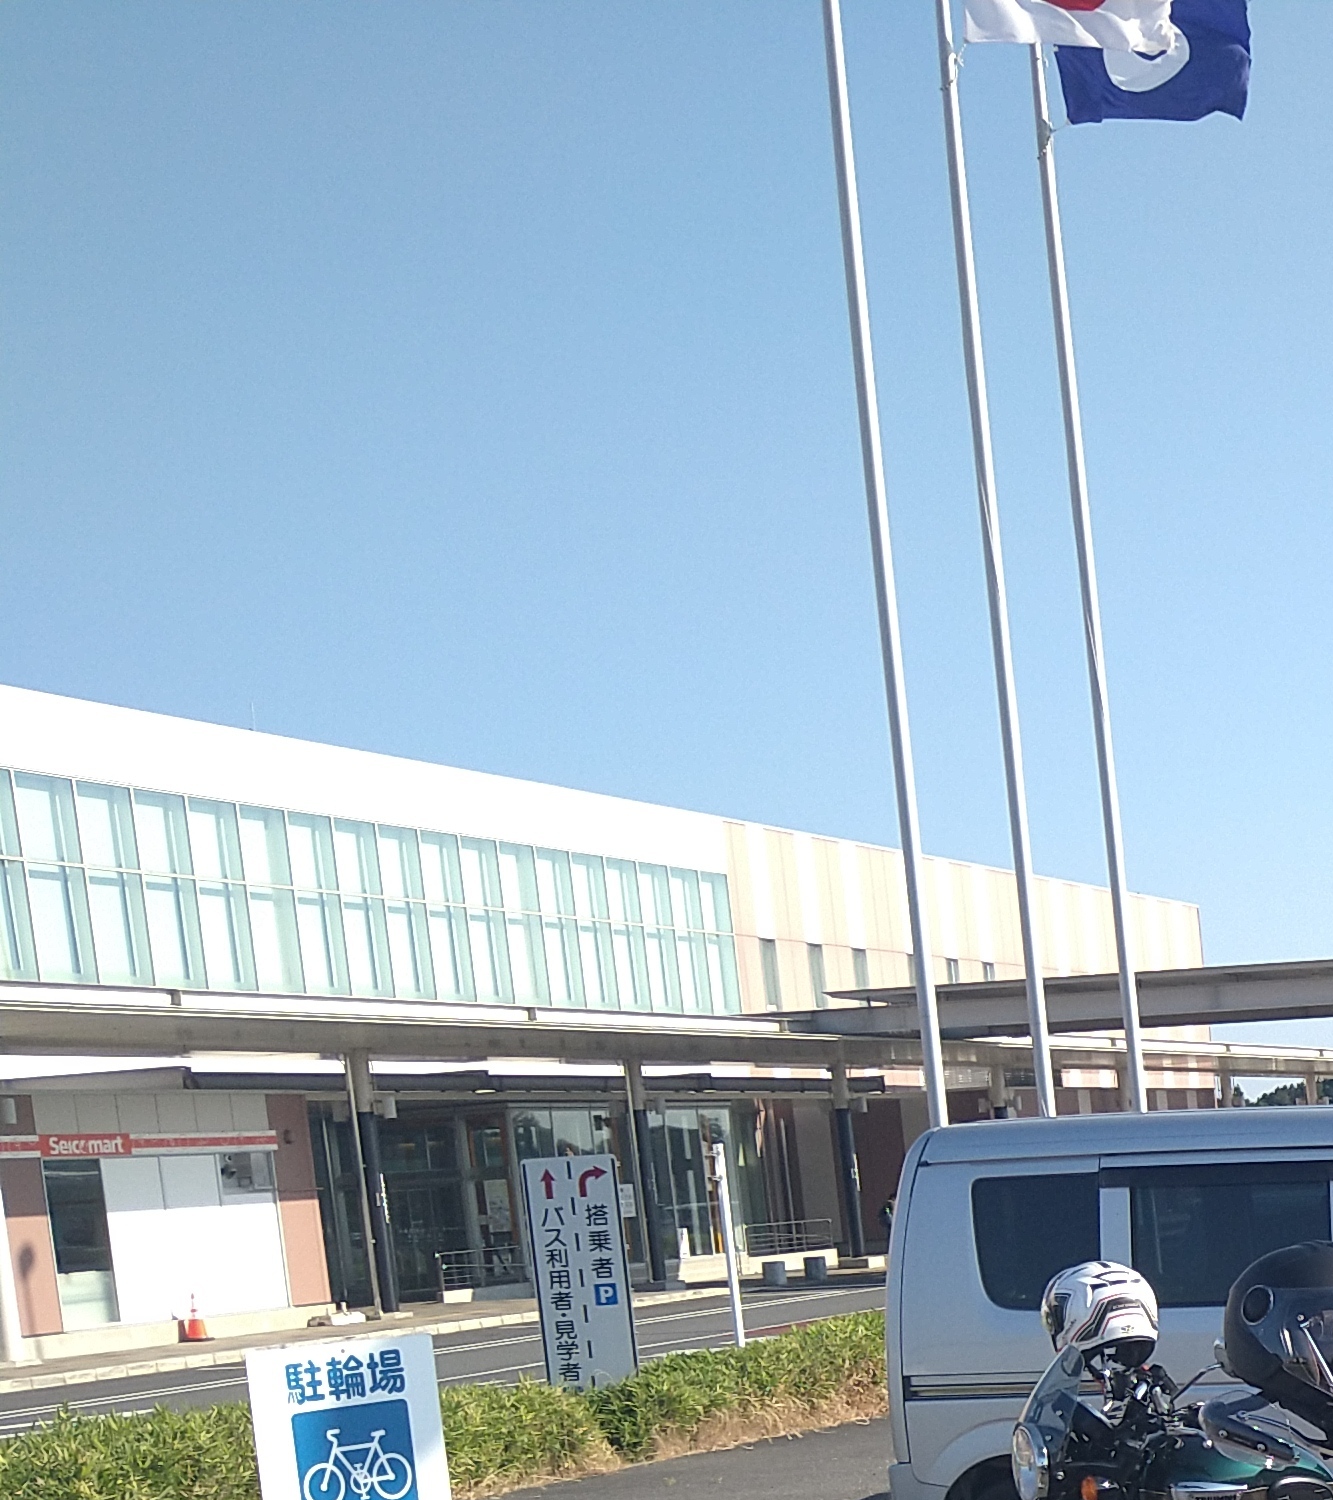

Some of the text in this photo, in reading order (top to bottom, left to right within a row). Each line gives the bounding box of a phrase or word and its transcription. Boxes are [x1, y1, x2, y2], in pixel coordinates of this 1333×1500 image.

[585, 1203, 616, 1279] 搭乗者
[541, 1206, 584, 1393] バス利用者・見学者
[285, 1349, 406, 1405] 駐輪場
